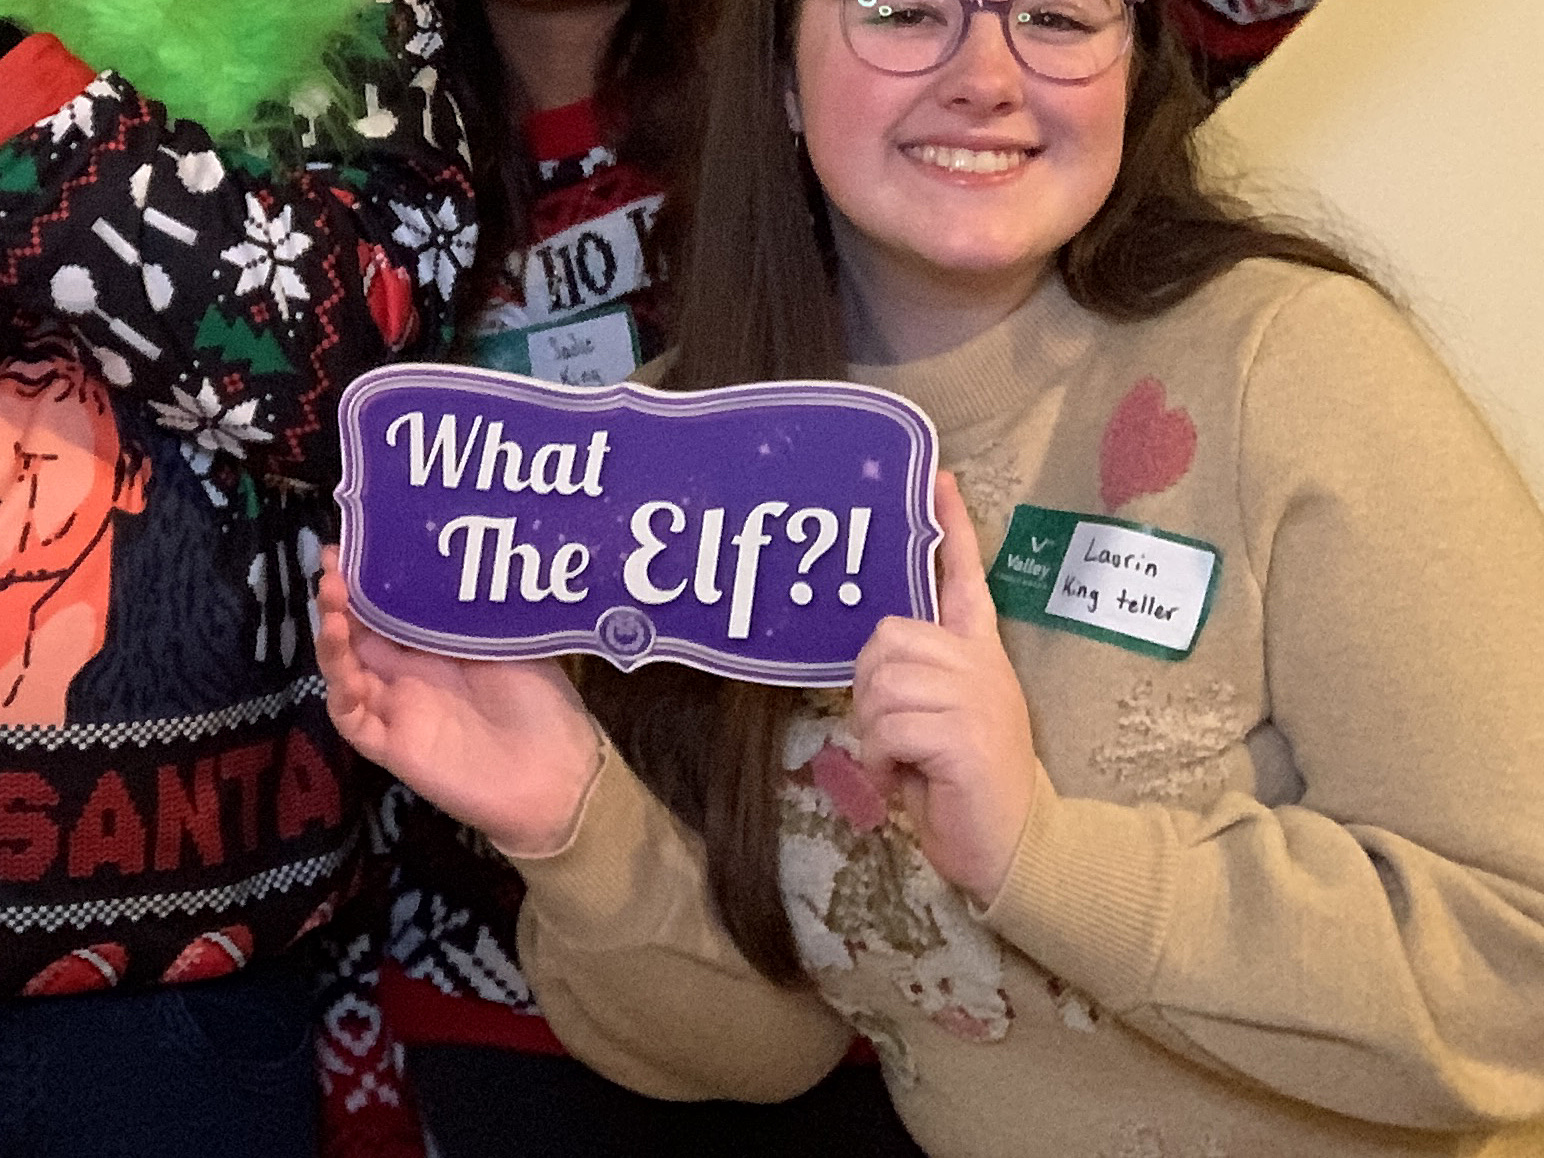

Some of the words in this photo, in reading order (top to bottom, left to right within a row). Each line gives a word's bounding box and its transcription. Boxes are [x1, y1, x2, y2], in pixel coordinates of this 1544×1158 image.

[386, 412, 610, 496] What
[438, 514, 591, 603] The
[623, 501, 872, 639] Elf?!
[1007, 553, 1051, 581] Valley
[1083, 538, 1158, 578] Laurin
[1116, 589, 1180, 621] teller
